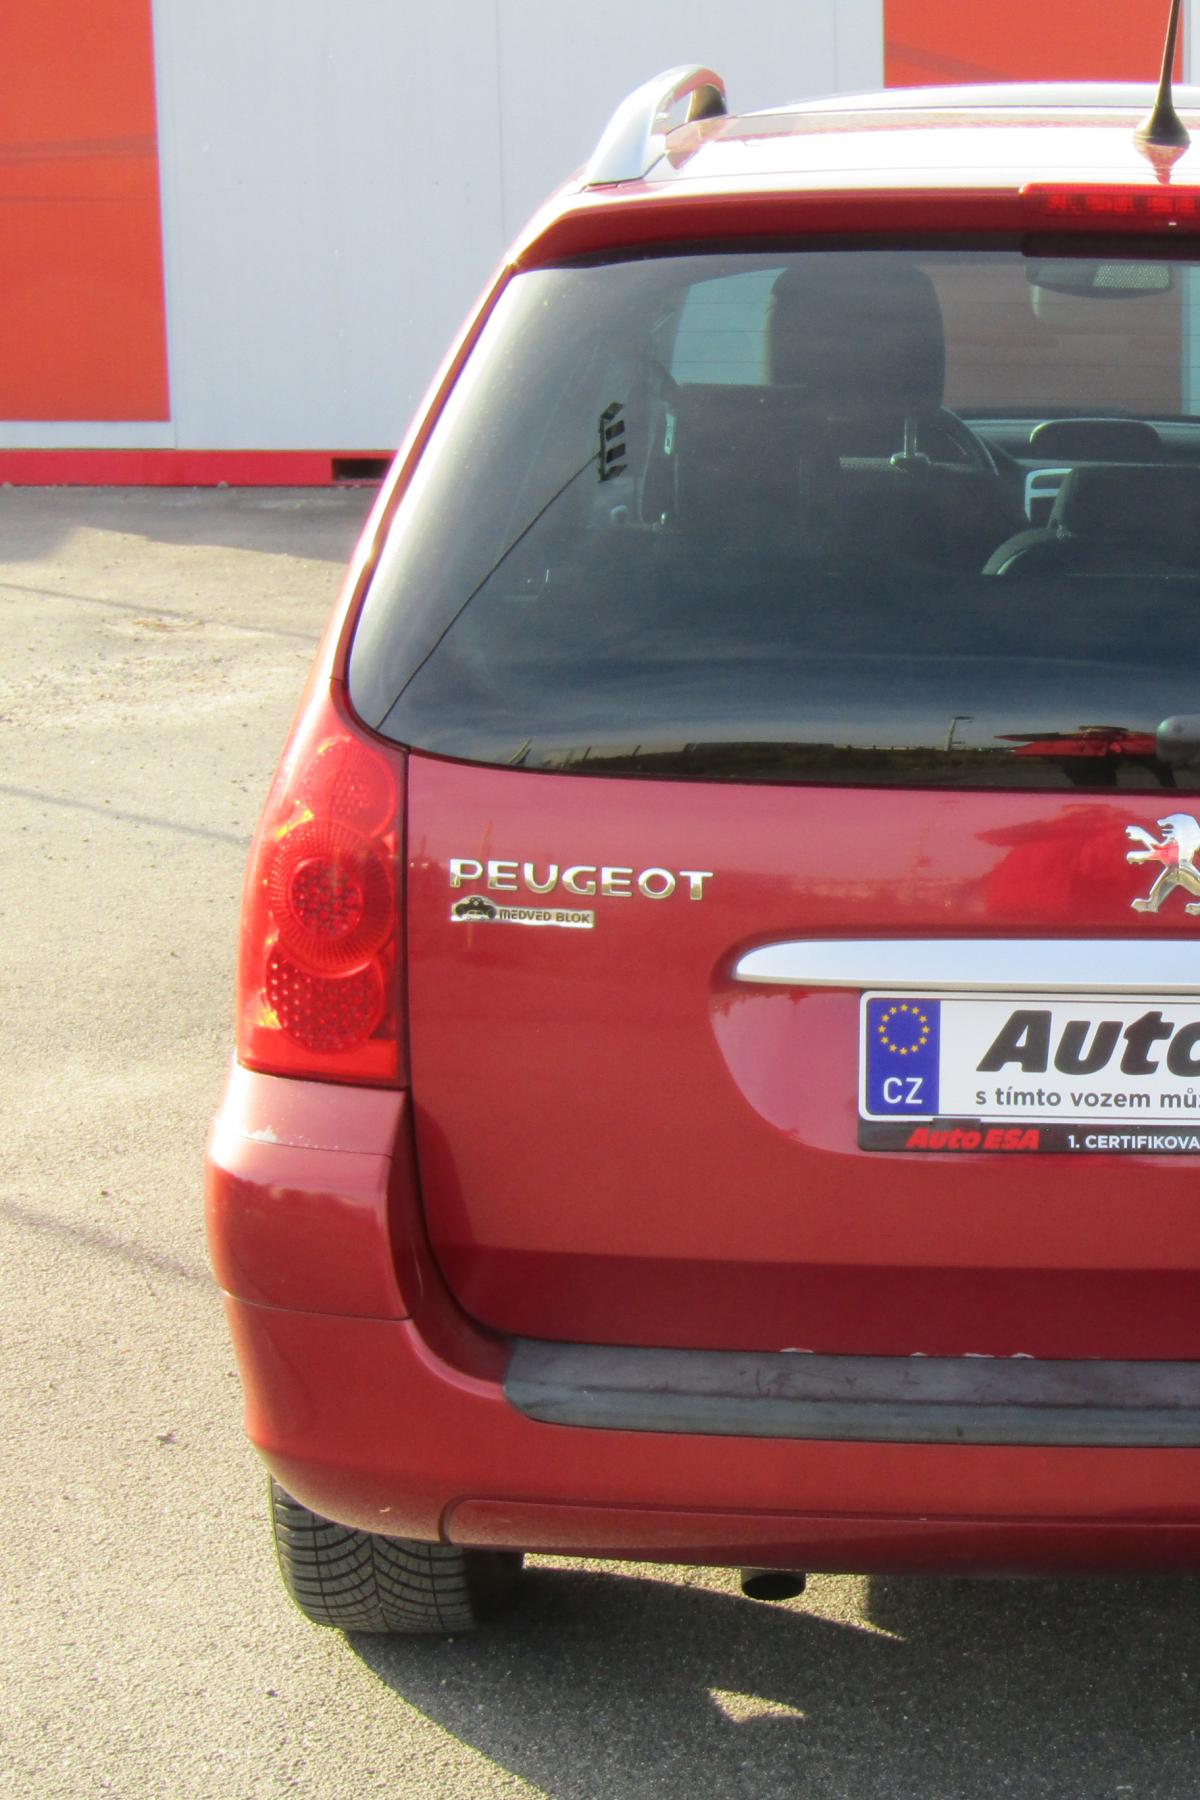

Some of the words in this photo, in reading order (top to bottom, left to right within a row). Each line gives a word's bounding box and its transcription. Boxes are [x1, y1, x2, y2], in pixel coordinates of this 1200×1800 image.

[449, 857, 714, 901] PEUGEOT
[499, 908, 553, 922] MEDVED
[555, 911, 592, 924] BLOK
[882, 1076, 924, 1105] CZ
[975, 1088, 987, 1105] s
[995, 1086, 1062, 1107] tímto
[1070, 1091, 1151, 1108] vozem
[905, 1127, 983, 1150] Auto
[983, 1129, 1041, 1150] ESA
[1067, 1134, 1081, 1149] 1.
